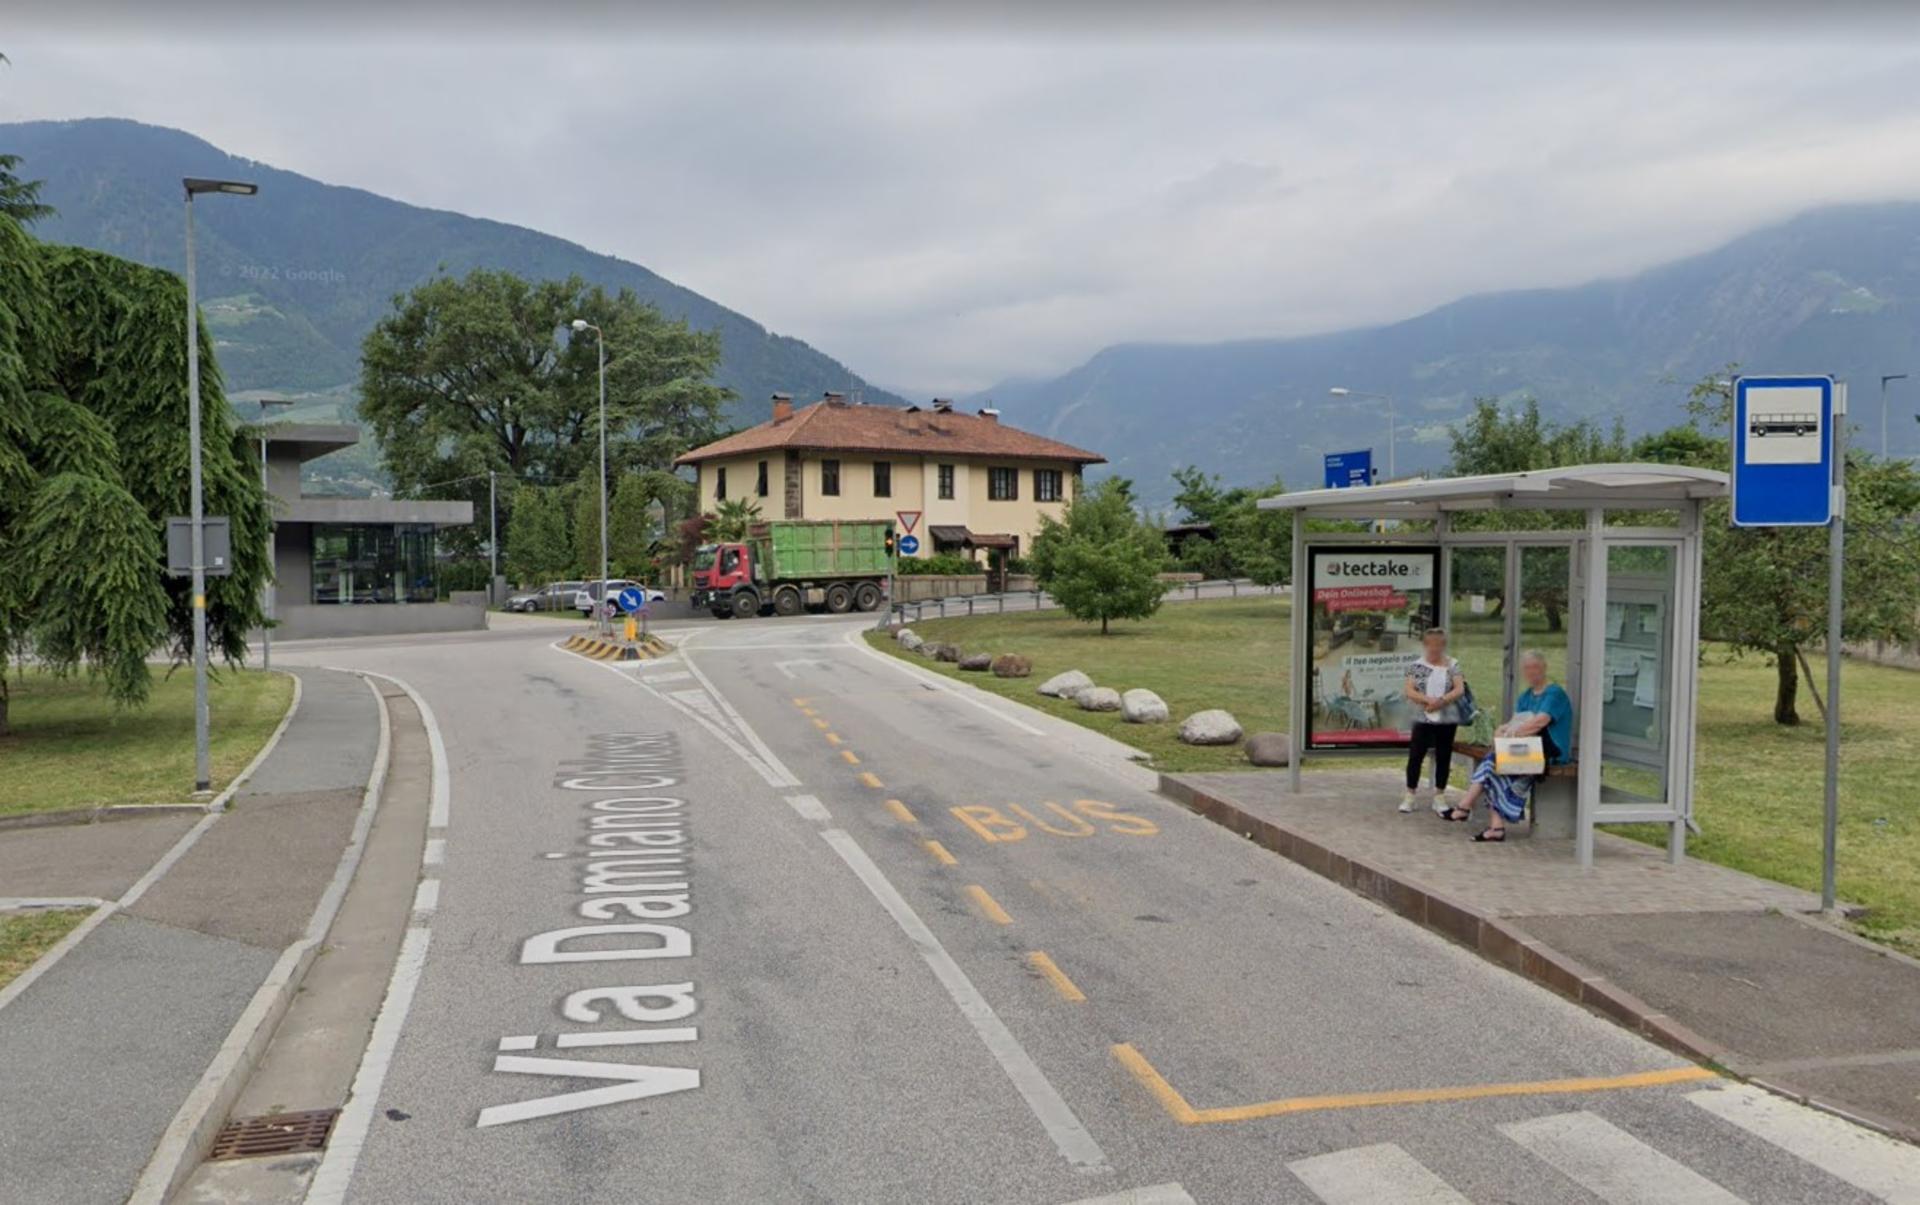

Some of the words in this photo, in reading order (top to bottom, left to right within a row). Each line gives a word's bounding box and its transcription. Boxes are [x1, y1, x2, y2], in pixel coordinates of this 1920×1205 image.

[1317, 590, 1339, 599] Dein
[1340, 587, 1391, 599] Onlineshop
[950, 799, 1160, 844] BUS
